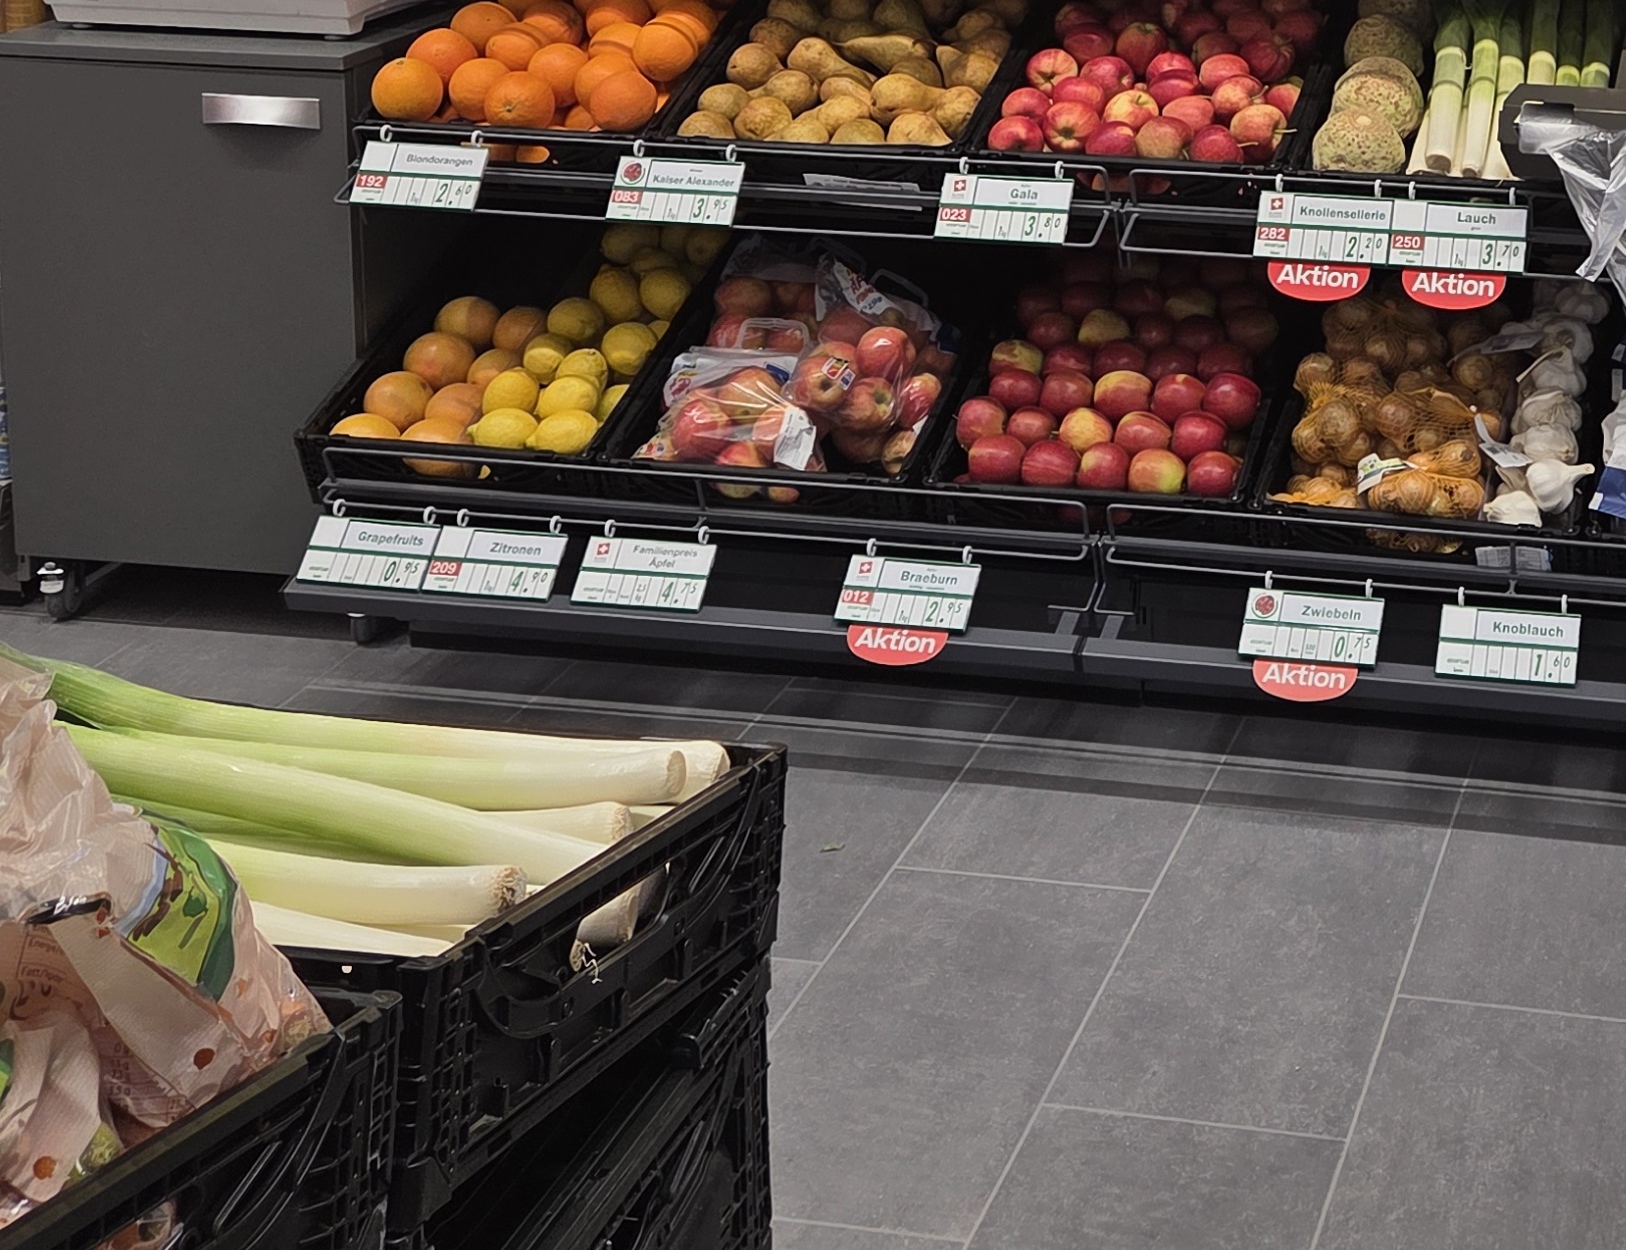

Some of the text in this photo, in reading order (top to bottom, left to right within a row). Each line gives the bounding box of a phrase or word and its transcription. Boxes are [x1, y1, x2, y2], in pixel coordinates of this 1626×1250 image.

[407, 154, 473, 167] Blondorangen
[359, 175, 384, 187] 192
[652, 174, 734, 188] Kaiser Alexander
[614, 191, 639, 203] 083
[1010, 189, 1038, 200] Gala
[942, 208, 967, 220] 023
[1300, 206, 1386, 221] Knollensellerie
[1457, 212, 1496, 224] Lauch
[1260, 228, 1286, 240] 282
[1346, 236, 1382, 259] 2.20
[1394, 236, 1420, 248] 250
[1482, 244, 1519, 267] 3.70
[1276, 260, 1359, 289] Aktion
[1411, 268, 1495, 297] Aktion
[359, 531, 423, 547] Grapefruits
[490, 542, 541, 555] Zitronen
[633, 545, 698, 557] Familienpreis
[431, 562, 457, 574] 209
[649, 559, 675, 569] Äpfel
[901, 570, 958, 585] Braeburn
[844, 590, 868, 602] 012
[1302, 605, 1361, 620] Zwiebeln
[1493, 622, 1564, 637] Knoblauch
[854, 628, 936, 654] Aktion
[1334, 636, 1371, 659] 0.75
[1262, 664, 1345, 690] Aktion
